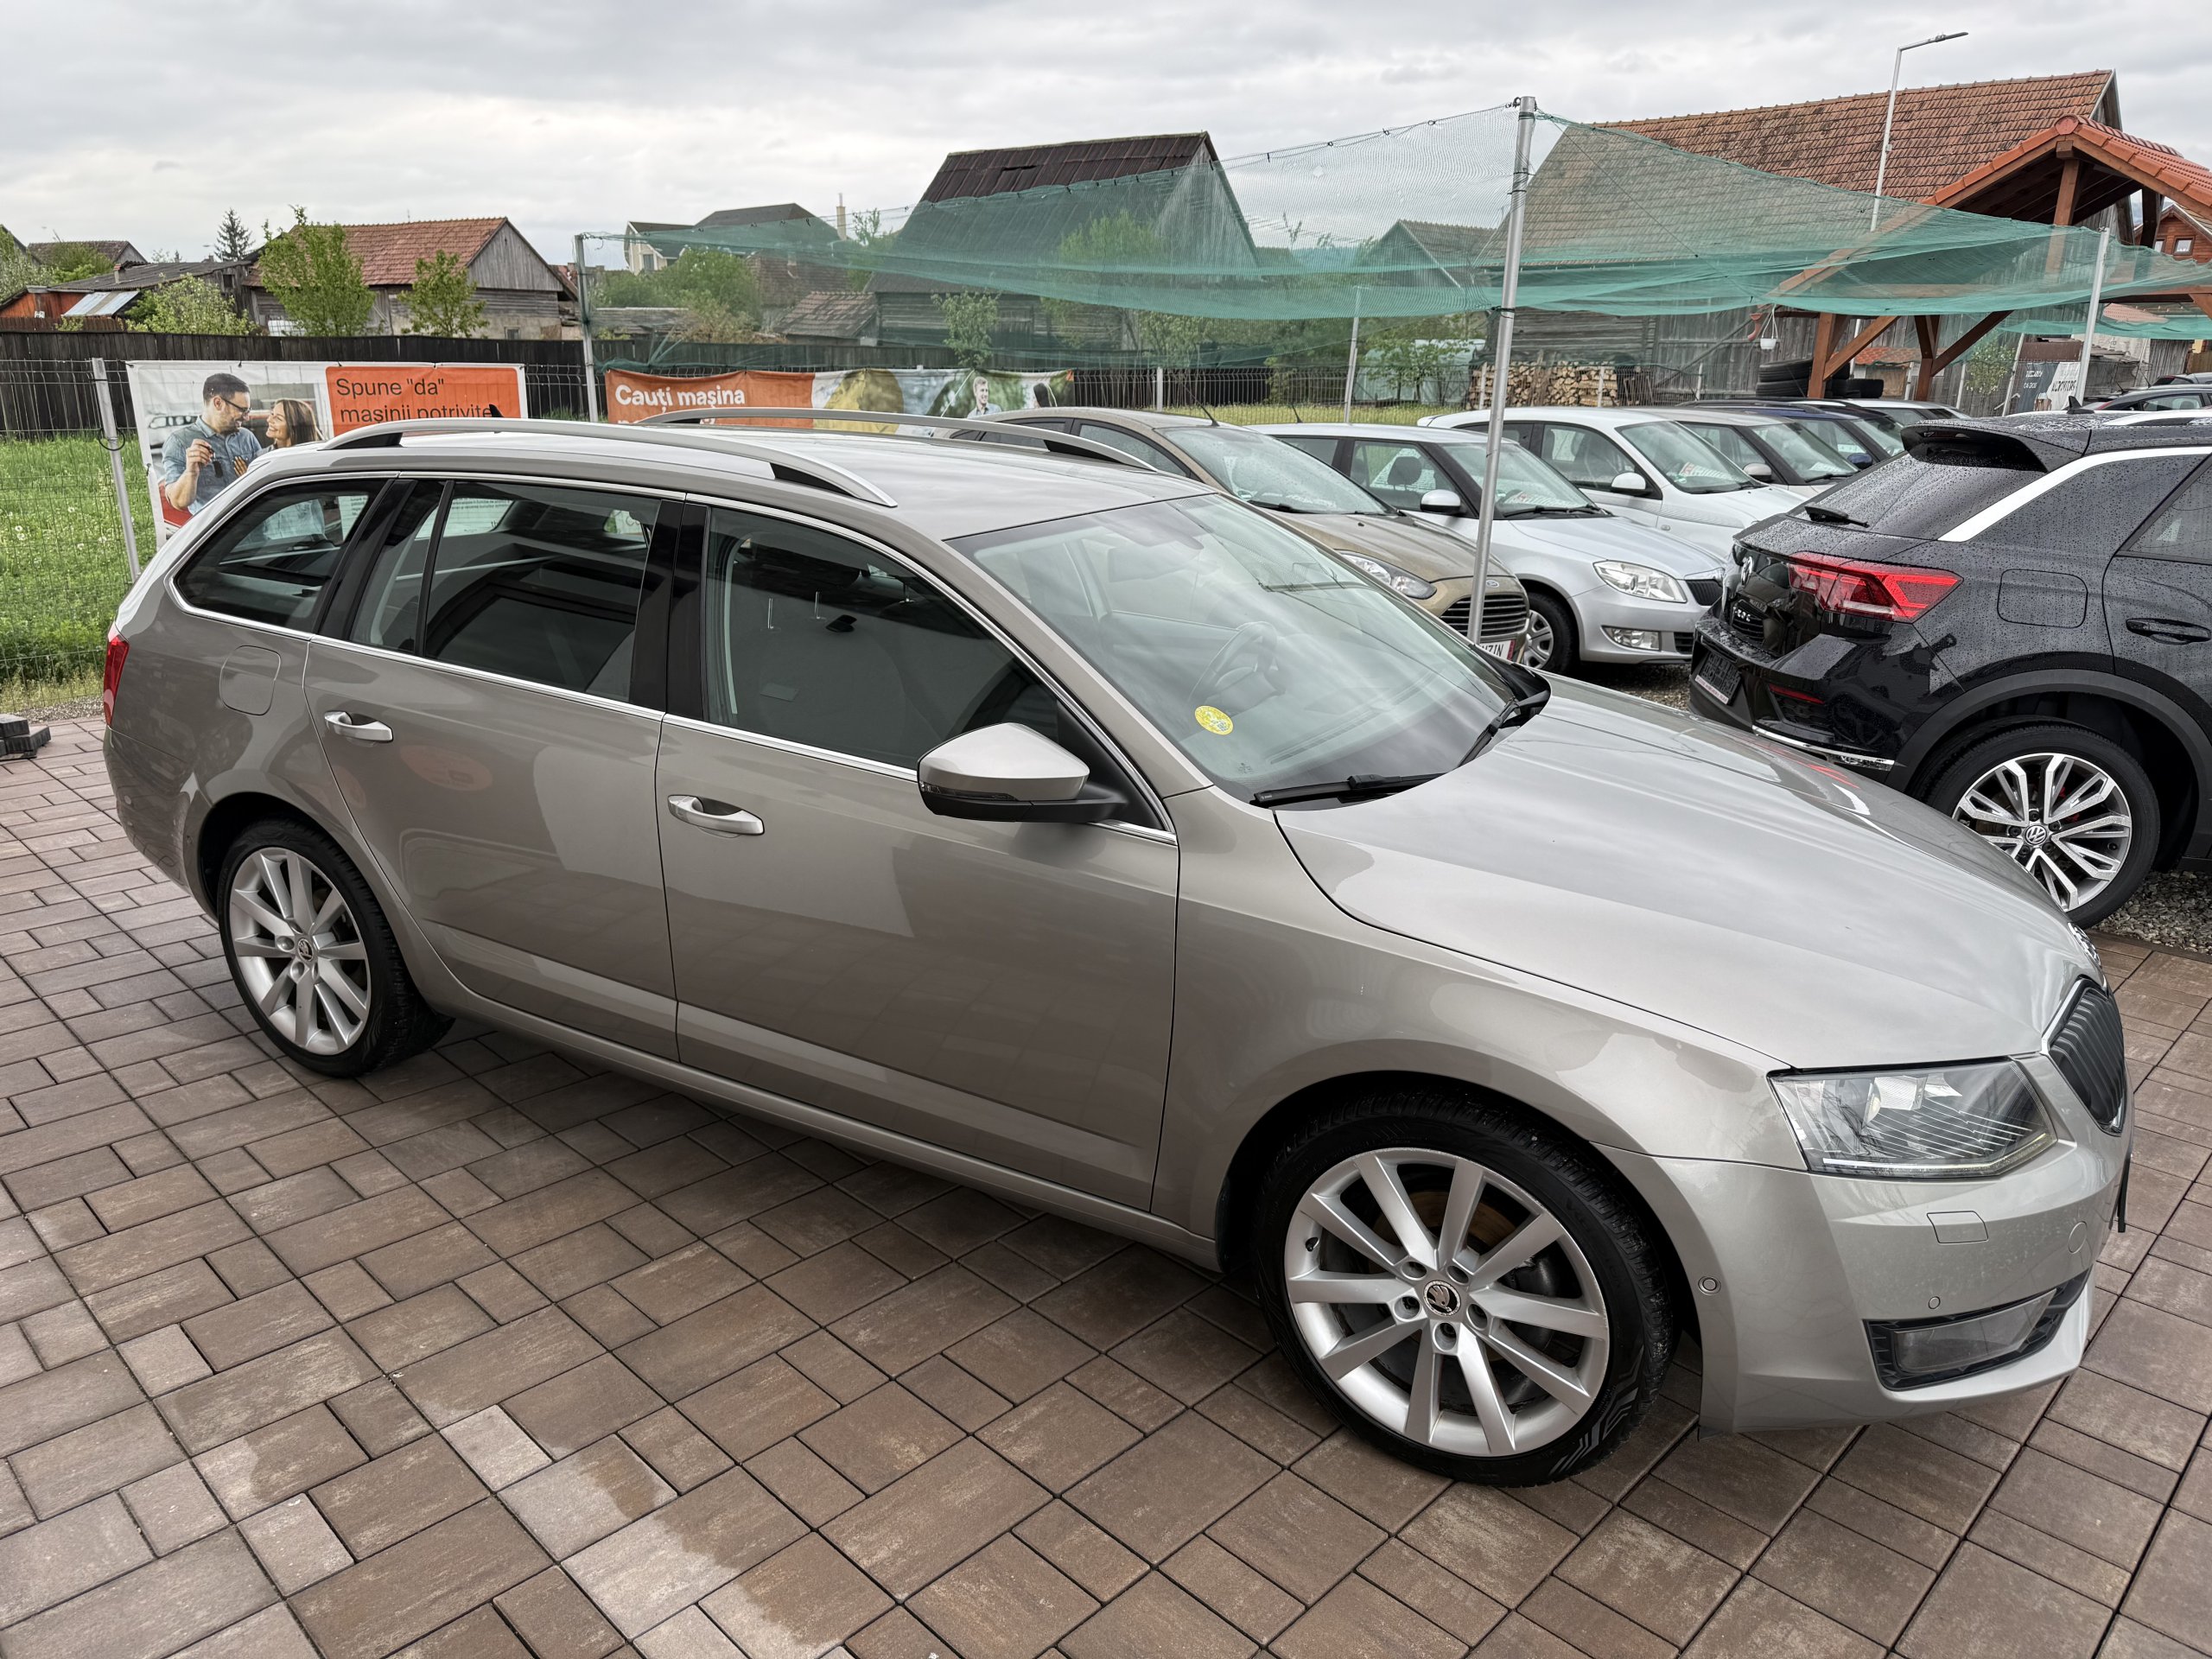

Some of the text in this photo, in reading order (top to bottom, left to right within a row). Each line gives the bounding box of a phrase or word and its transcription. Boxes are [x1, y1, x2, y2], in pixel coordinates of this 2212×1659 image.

[336, 378, 444, 398] Spune "da"
[615, 385, 746, 414] Cauți mașina
